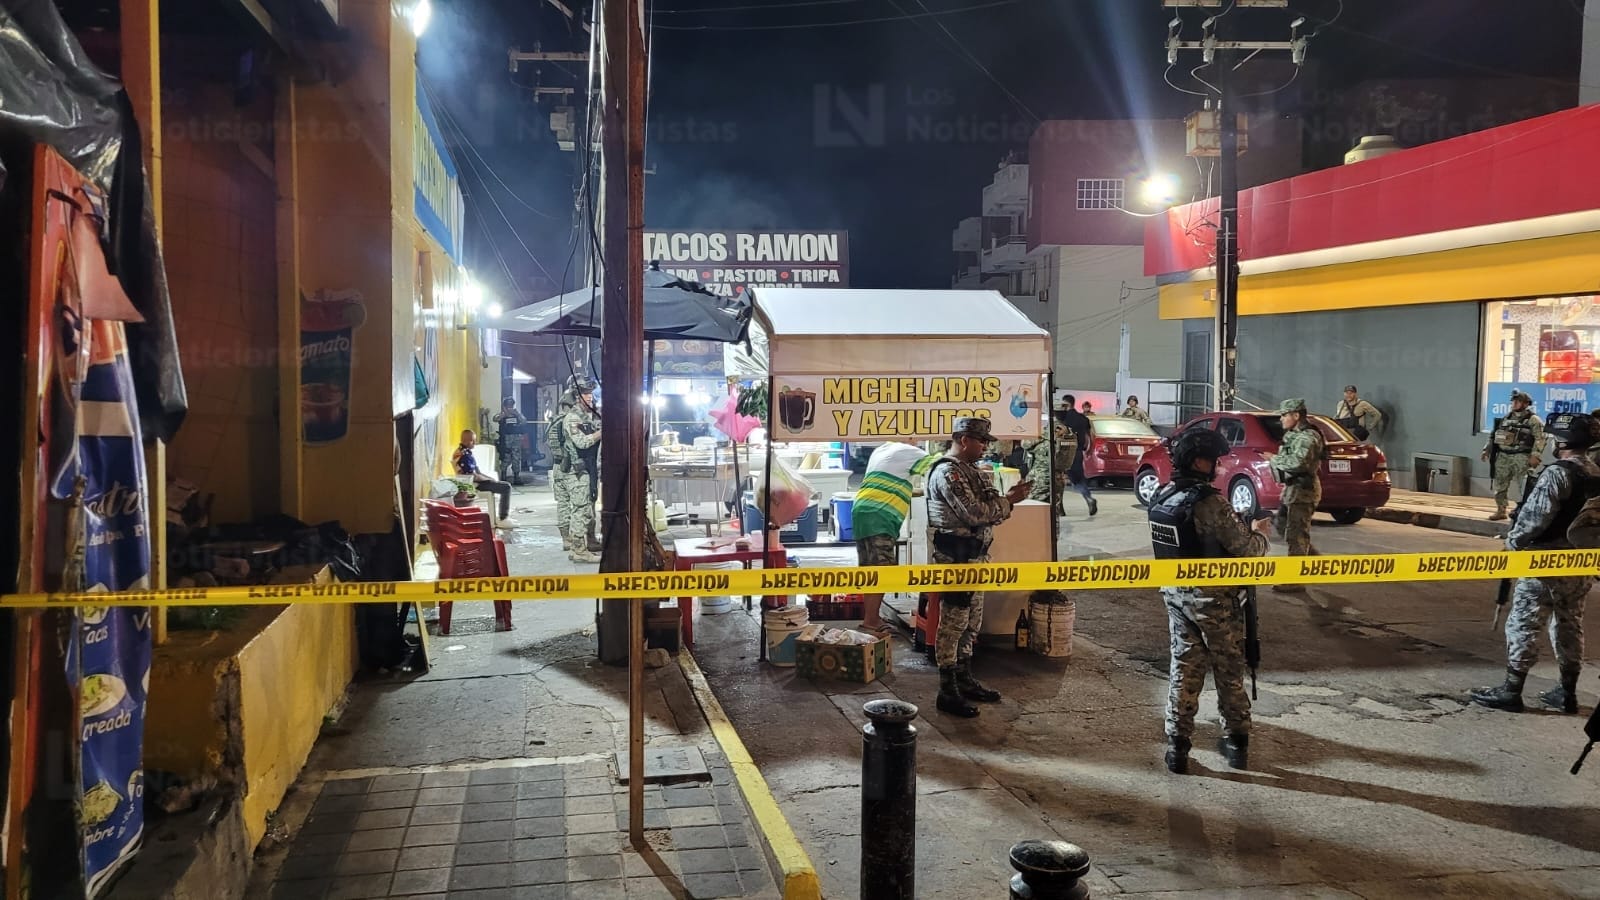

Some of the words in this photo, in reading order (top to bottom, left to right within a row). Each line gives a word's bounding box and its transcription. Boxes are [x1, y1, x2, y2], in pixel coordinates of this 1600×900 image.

[643, 232, 727, 261] TACOS
[736, 233, 838, 262] RAMON
[713, 269, 777, 283] PASTOR
[791, 269, 840, 283] TRIPA
[822, 377, 1001, 404] MICHELADAS
[832, 410, 852, 436] Y
